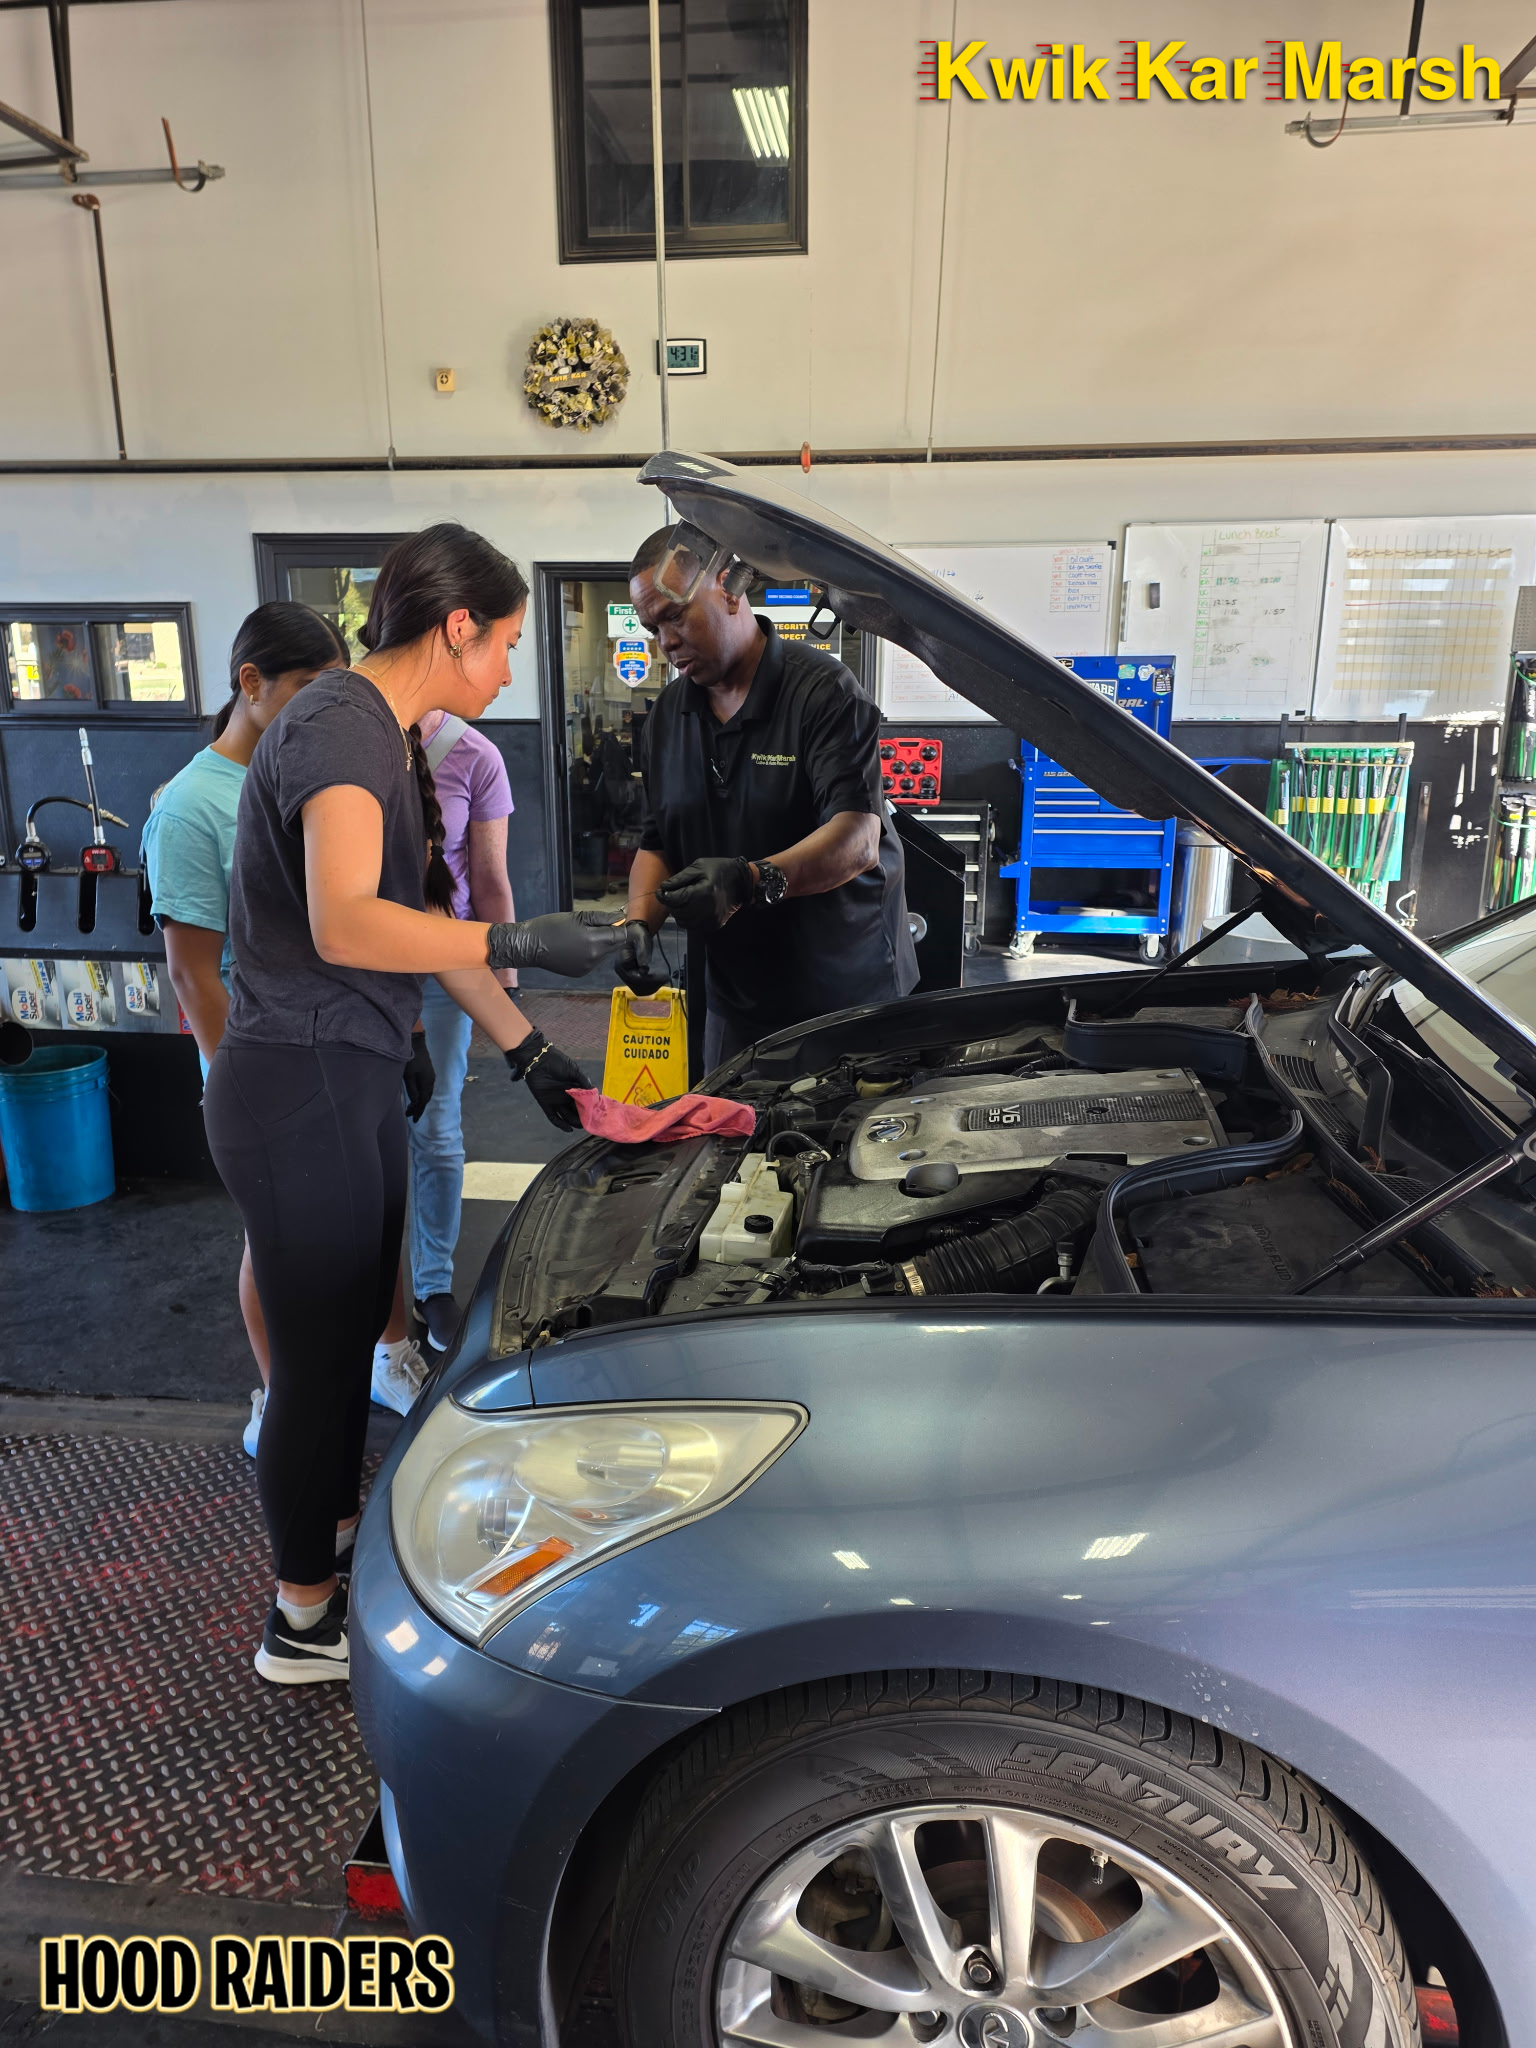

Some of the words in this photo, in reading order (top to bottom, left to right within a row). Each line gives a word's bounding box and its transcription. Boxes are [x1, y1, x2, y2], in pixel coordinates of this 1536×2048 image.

[670, 346, 694, 361] 4:31
[614, 606, 633, 615] First
[17, 990, 29, 1020] Mobil
[28, 991, 38, 1020] Super
[73, 992, 85, 1022] Mobil
[84, 993, 93, 1022] Super
[127, 986, 136, 1010] Mobil
[136, 987, 145, 1010] Super
[623, 1034, 671, 1046] CAUTION
[624, 1048, 670, 1060] CUIDADO
[1002, 1104, 1021, 1124] V6
[1250, 1223, 1279, 1255] BRAKE
[1267, 1254, 1293, 1281] FLUID
[953, 1785, 992, 1793] EXTRA
[998, 1789, 1030, 1799] LOAD
[656, 1853, 701, 1936] UHP
